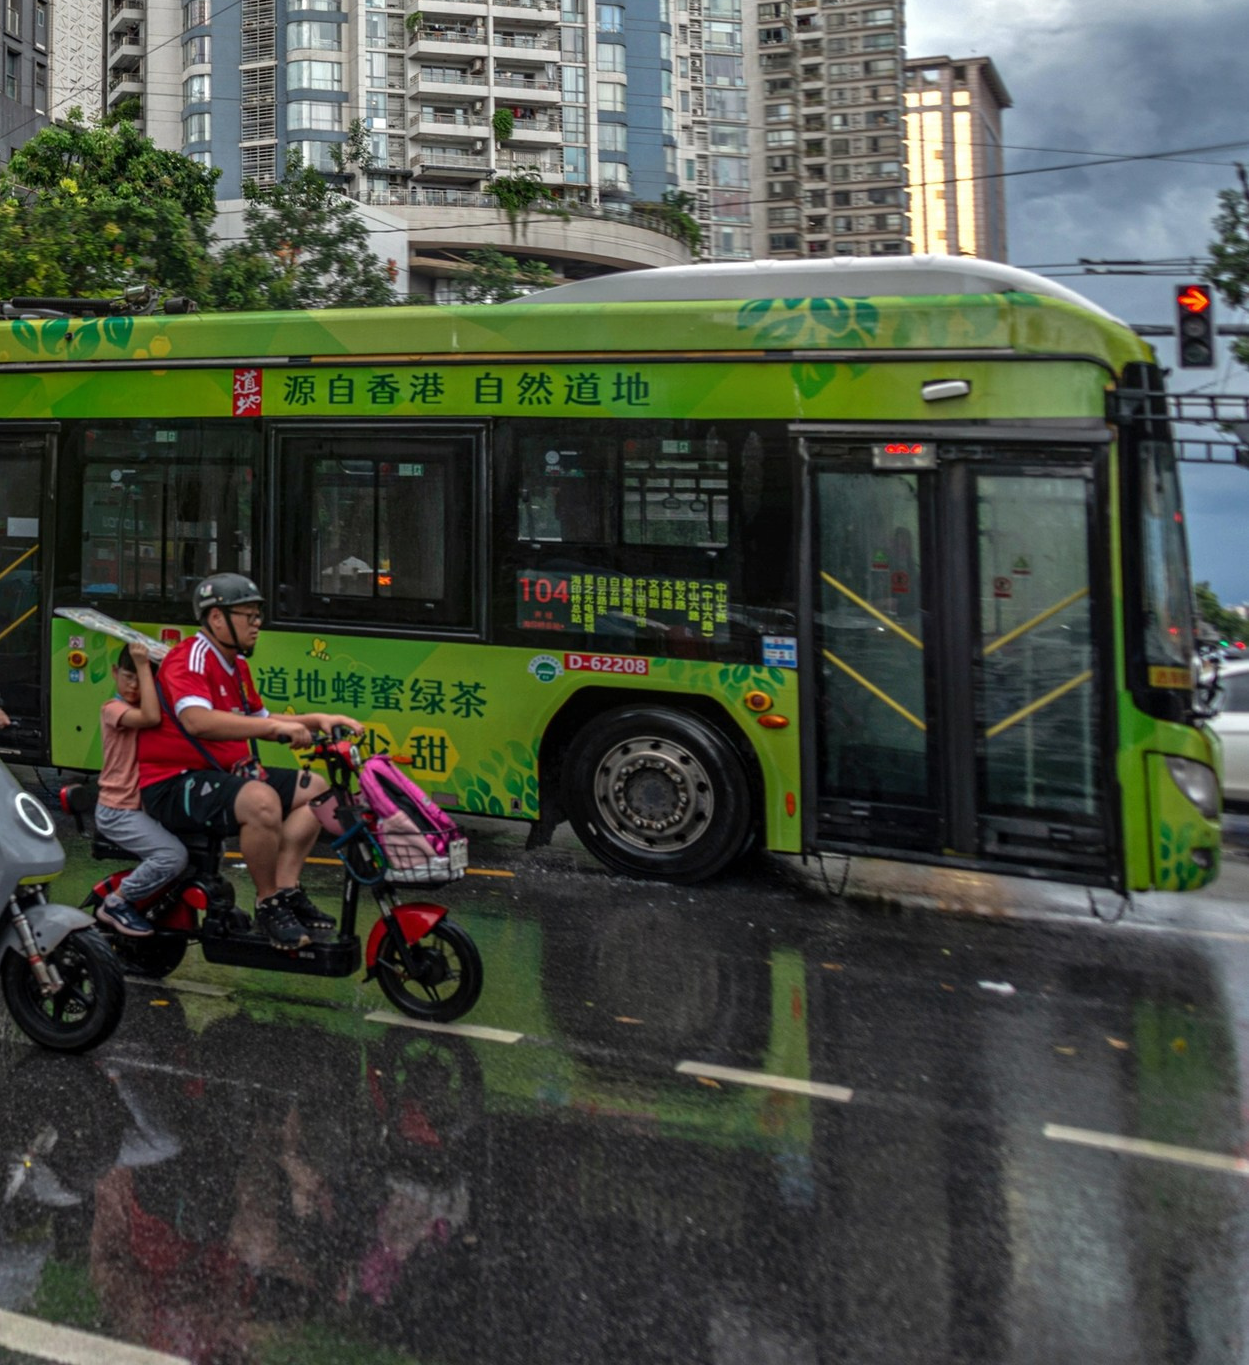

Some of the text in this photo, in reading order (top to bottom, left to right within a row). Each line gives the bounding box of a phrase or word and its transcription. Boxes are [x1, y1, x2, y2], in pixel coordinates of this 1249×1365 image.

[233, 370, 262, 415] 道地
[283, 372, 652, 407] 源自香港 自然道地
[518, 576, 570, 604] 104
[610, 576, 621, 607] 白云路
[648, 579, 660, 609] 文明路
[662, 580, 673, 610] 大南路
[688, 581, 700, 622] 中山六路
[715, 582, 728, 623] 中山七路
[569, 654, 647, 674] D-62208
[257, 666, 488, 719] 道地蜂蜜绿茶
